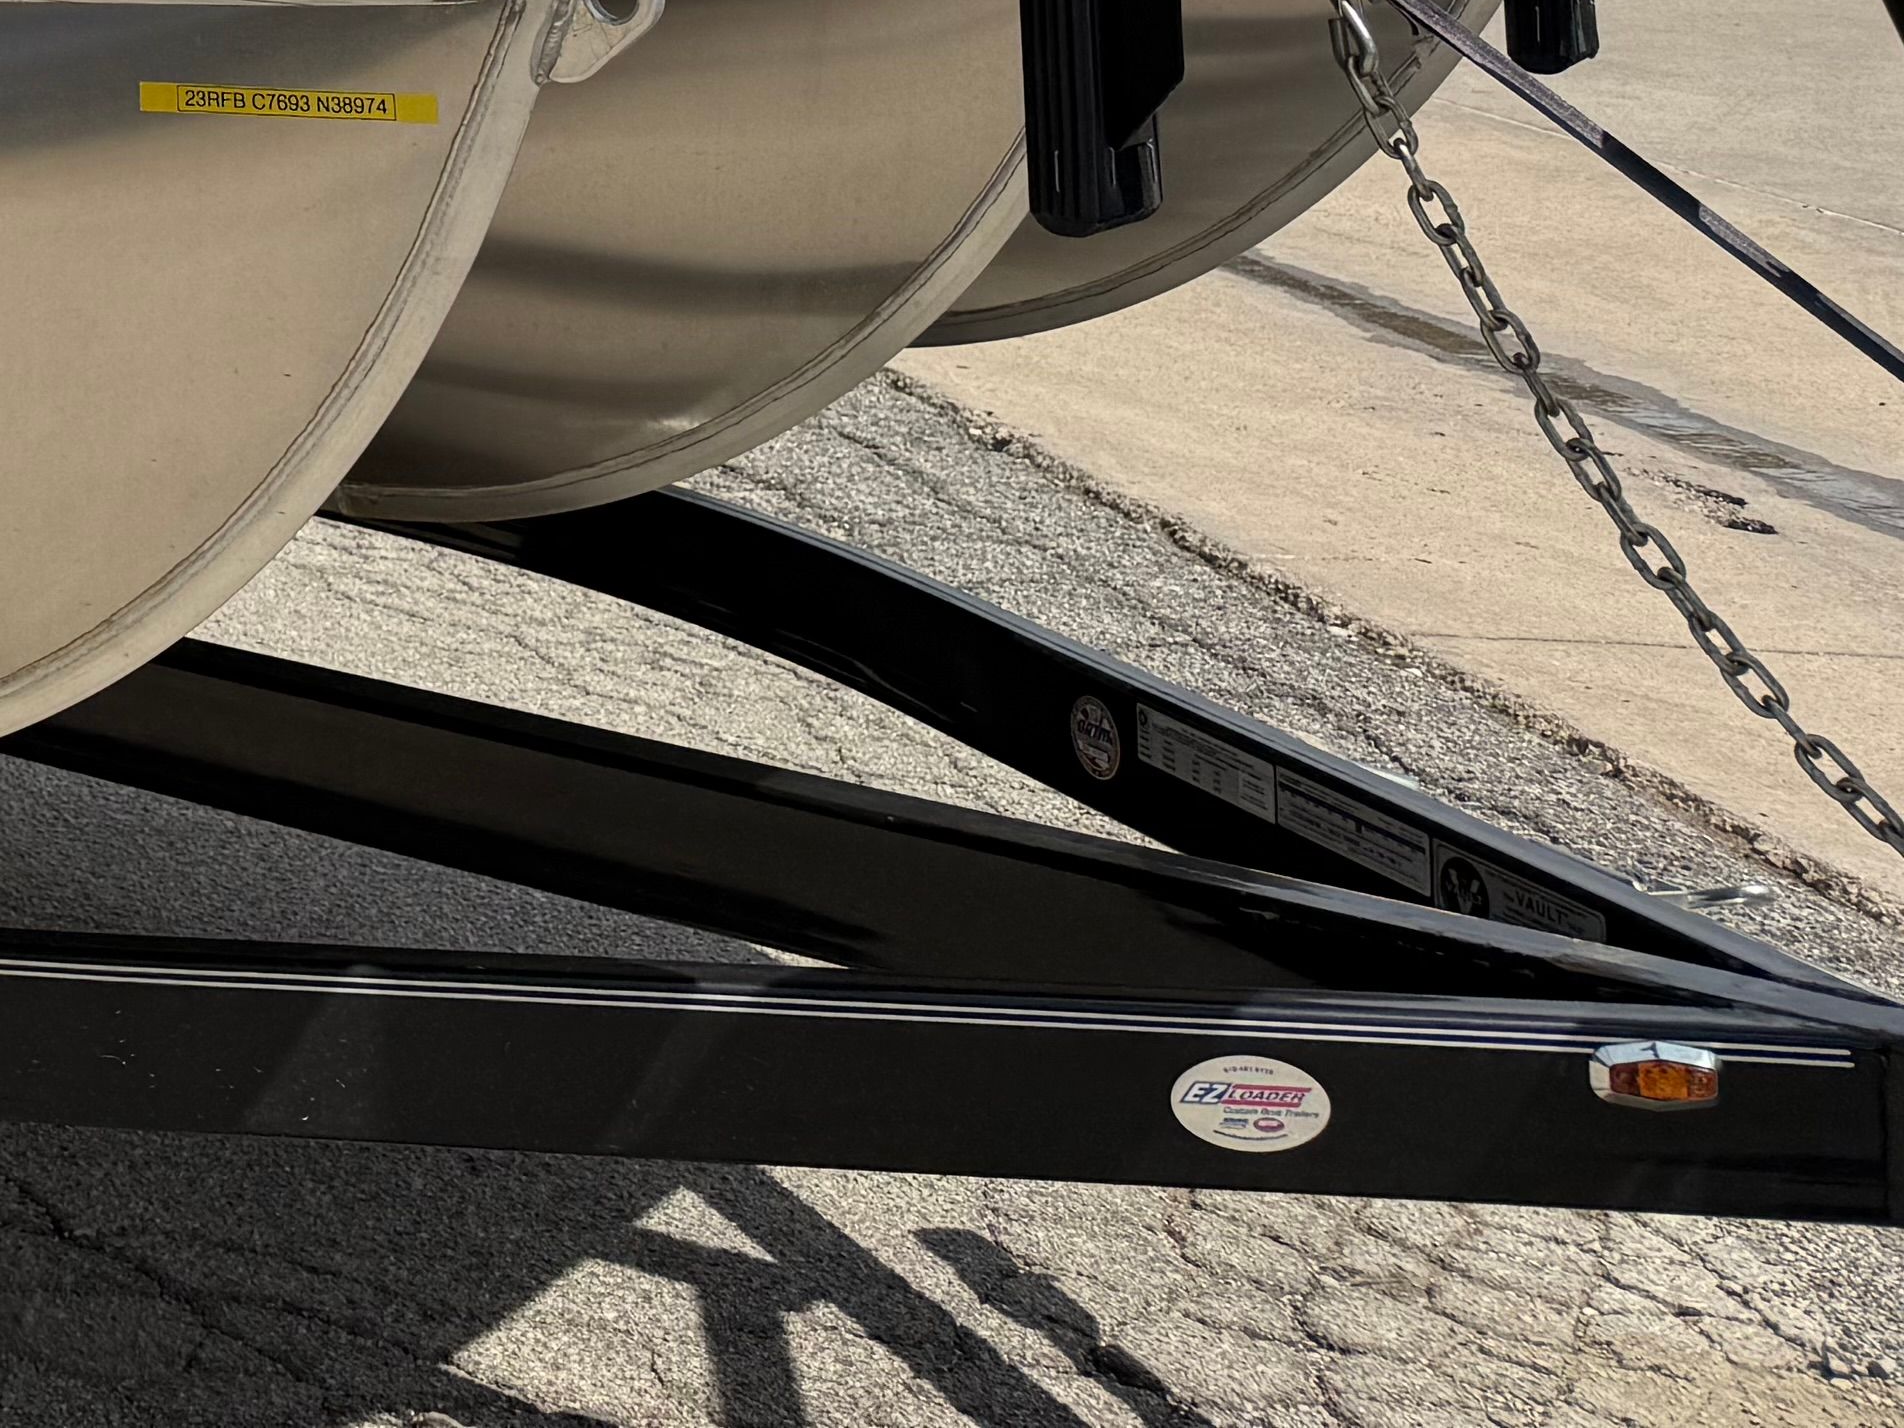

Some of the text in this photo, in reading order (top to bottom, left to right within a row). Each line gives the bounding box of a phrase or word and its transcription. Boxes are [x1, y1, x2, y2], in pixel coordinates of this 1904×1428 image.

[184, 89, 388, 115] 23RFB C7693 N38974
[1515, 890, 1564, 925] VAULT
[1181, 1082, 1229, 1105] EZ
